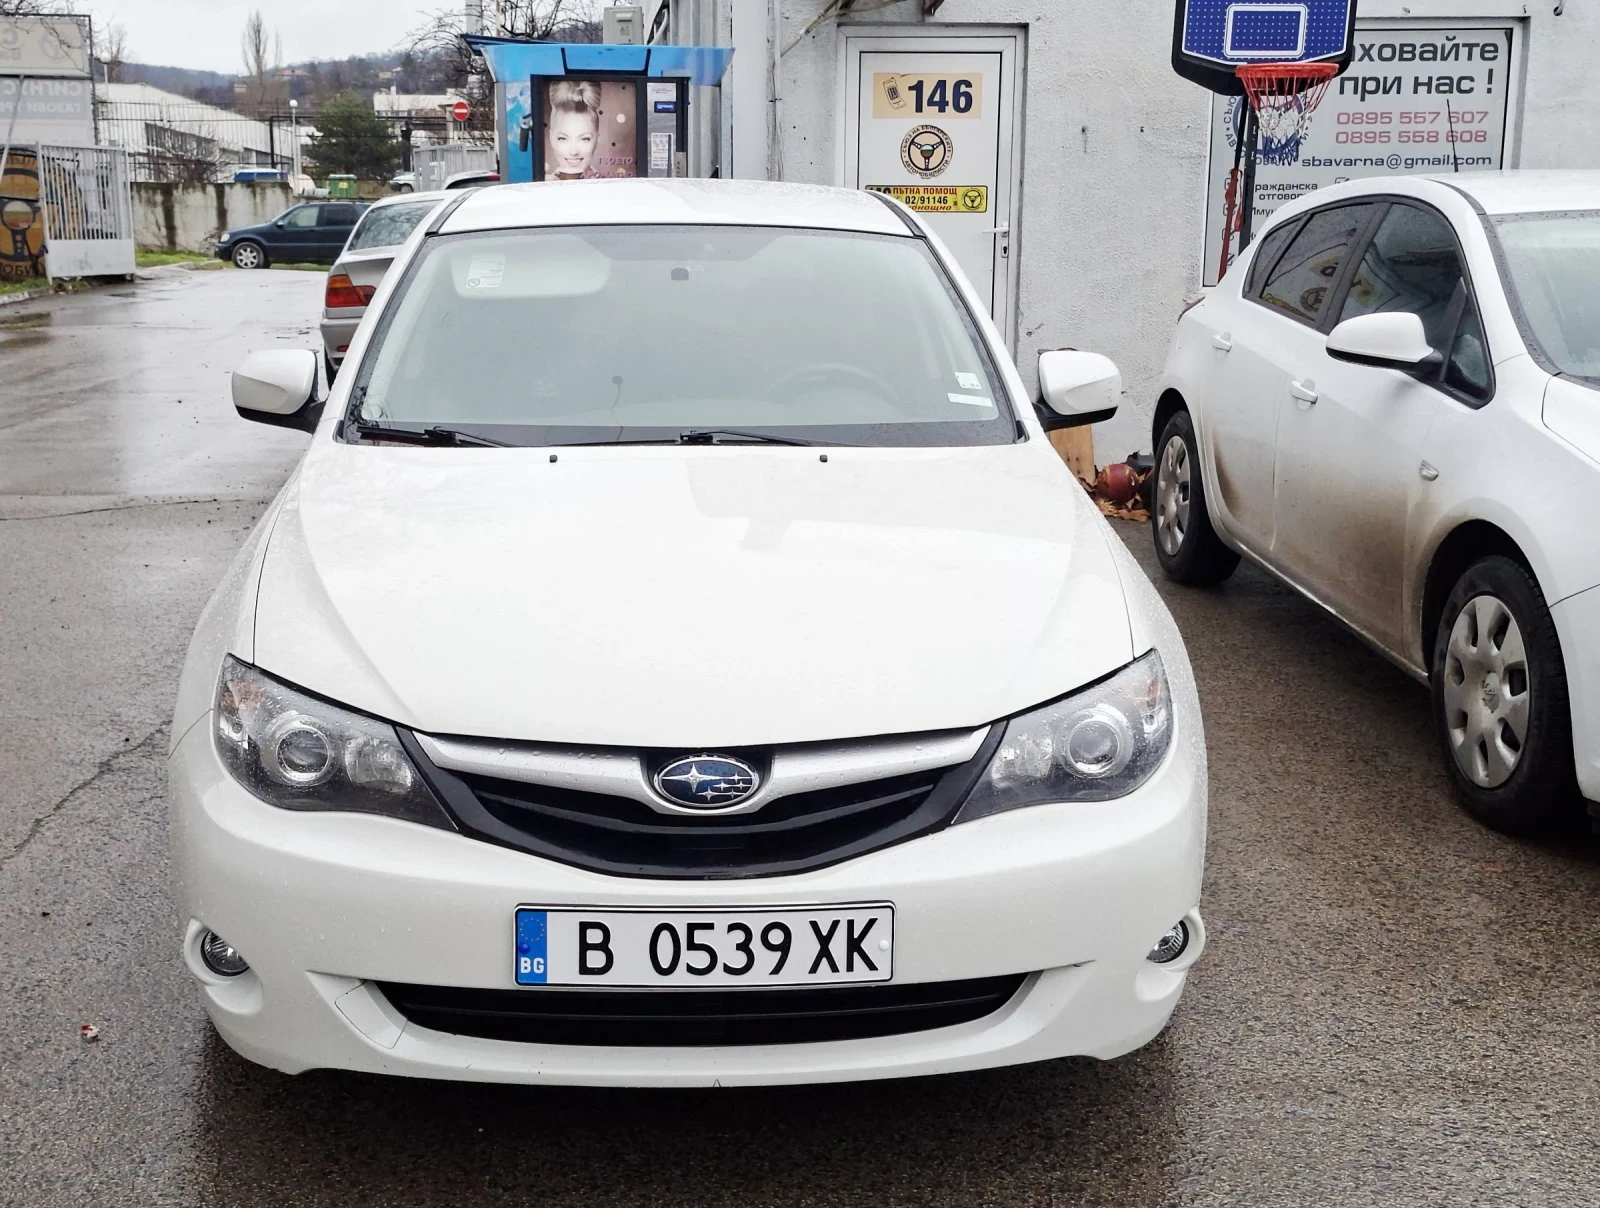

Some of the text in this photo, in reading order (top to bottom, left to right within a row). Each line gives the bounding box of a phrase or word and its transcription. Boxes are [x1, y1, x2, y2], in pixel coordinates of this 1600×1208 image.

[908, 79, 973, 113] 146
[1339, 76, 1402, 102] при
[1413, 76, 1475, 94] нас
[1336, 111, 1489, 125] 0895 557 607
[1335, 130, 1487, 144] 0895 558 608
[1301, 154, 1492, 170] sbavarna@gmail.com
[893, 187, 921, 195] ПЪТНА
[923, 187, 957, 195] ПОМОЩ
[1255, 183, 1318, 192] ражданска
[905, 196, 948, 205] 02/91146
[649, 921, 792, 976] 0539
[520, 957, 545, 974] BG
